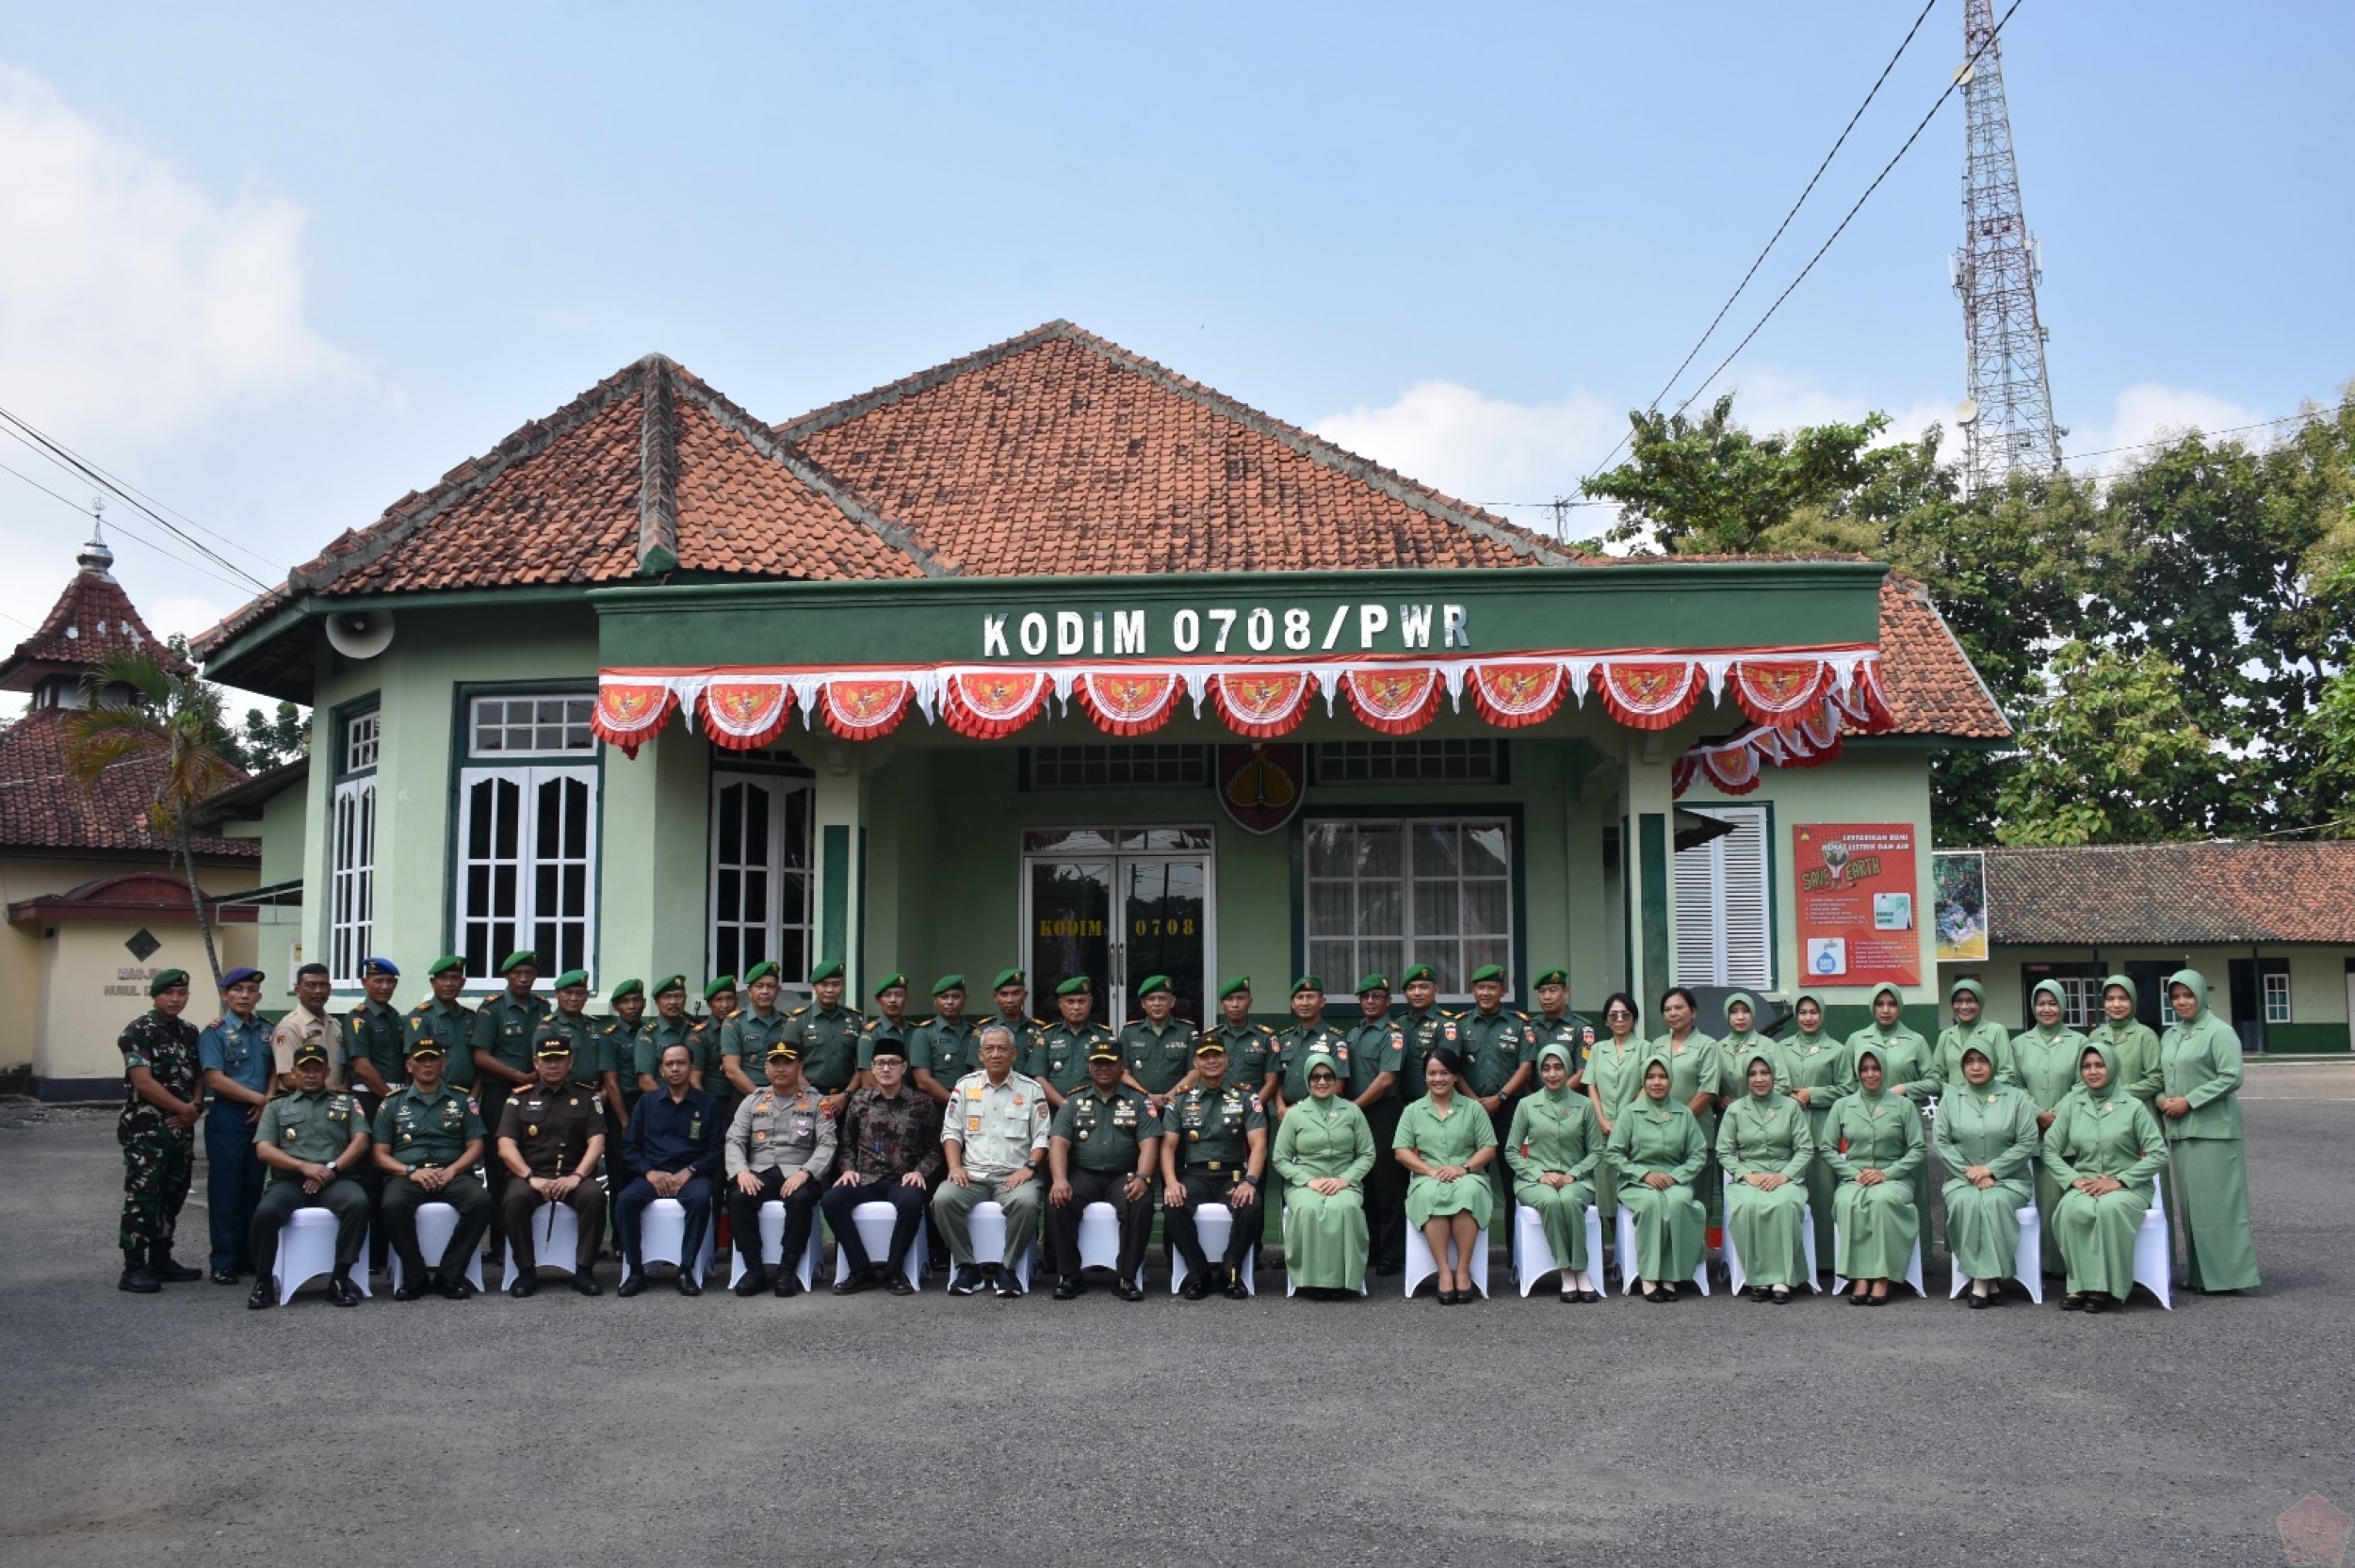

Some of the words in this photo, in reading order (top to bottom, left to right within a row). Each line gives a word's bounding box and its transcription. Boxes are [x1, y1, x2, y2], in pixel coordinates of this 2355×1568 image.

[983, 609, 1146, 657] KODIM
[1173, 604, 1470, 653] 0708/PWR
[1801, 869, 1830, 891] SAVE
[1845, 857, 1880, 881] EARTH
[1040, 920, 1102, 936] KODIM
[1135, 918, 1194, 936] 0708
[105, 985, 140, 995] NURUL
